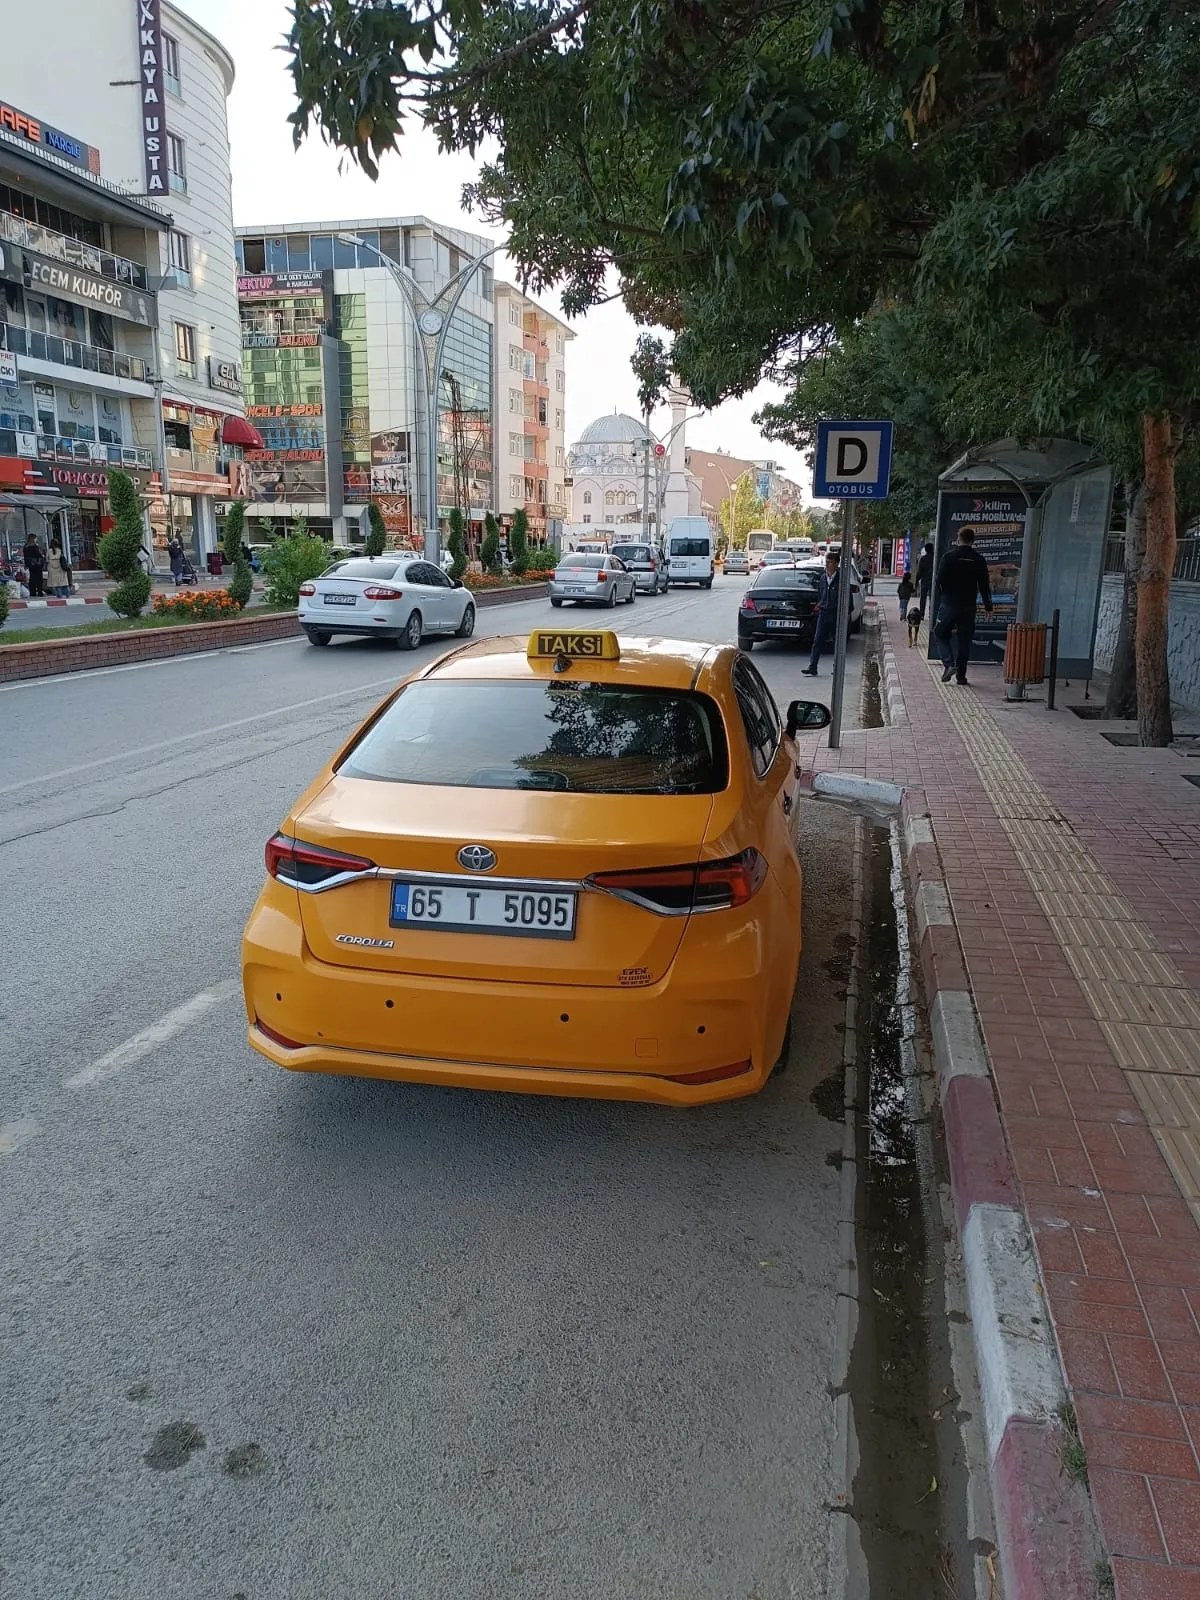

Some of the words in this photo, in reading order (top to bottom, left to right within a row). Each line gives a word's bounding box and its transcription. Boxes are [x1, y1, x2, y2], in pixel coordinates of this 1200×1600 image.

[141, 30, 158, 103] KAYA
[0, 105, 41, 142] AFE
[145, 117, 163, 189] USTA
[31, 261, 69, 290] ECEM
[72, 276, 122, 307] KUAFÖR
[280, 335, 318, 346] SALONU
[280, 450, 324, 461] SALONU
[836, 437, 867, 476] D
[828, 485, 873, 494] OTOBÜS
[951, 512, 981, 521] ALYANS
[984, 501, 1010, 511] kilim
[395, 903, 406, 912] TR
[411, 888, 443, 919] 65
[466, 891, 480, 921] T
[504, 894, 569, 927] 5095
[335, 934, 394, 948] COROLLA
